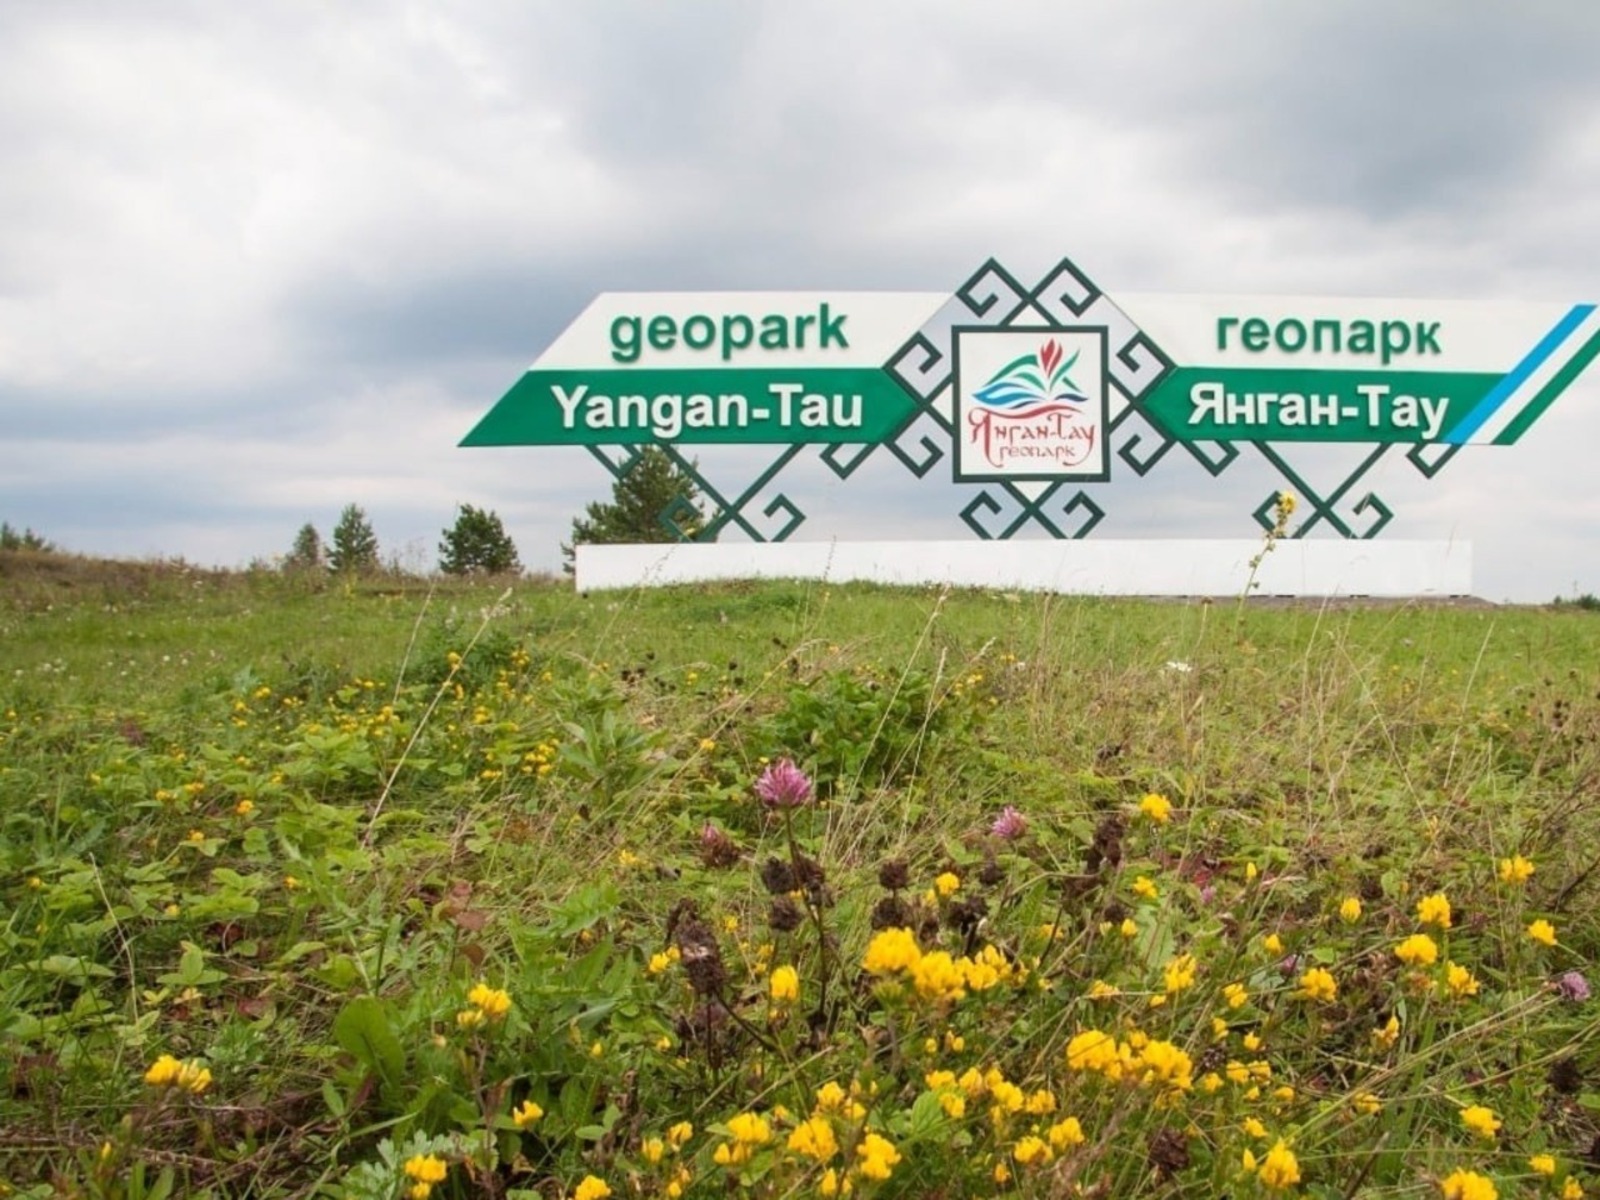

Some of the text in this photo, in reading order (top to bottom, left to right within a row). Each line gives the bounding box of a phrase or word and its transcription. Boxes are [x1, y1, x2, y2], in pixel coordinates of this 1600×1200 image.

[610, 303, 849, 362] geopark
[1216, 316, 1441, 365] геопарк
[551, 383, 863, 438] Yangan-Tau
[1188, 382, 1449, 439] Янган-Тау
